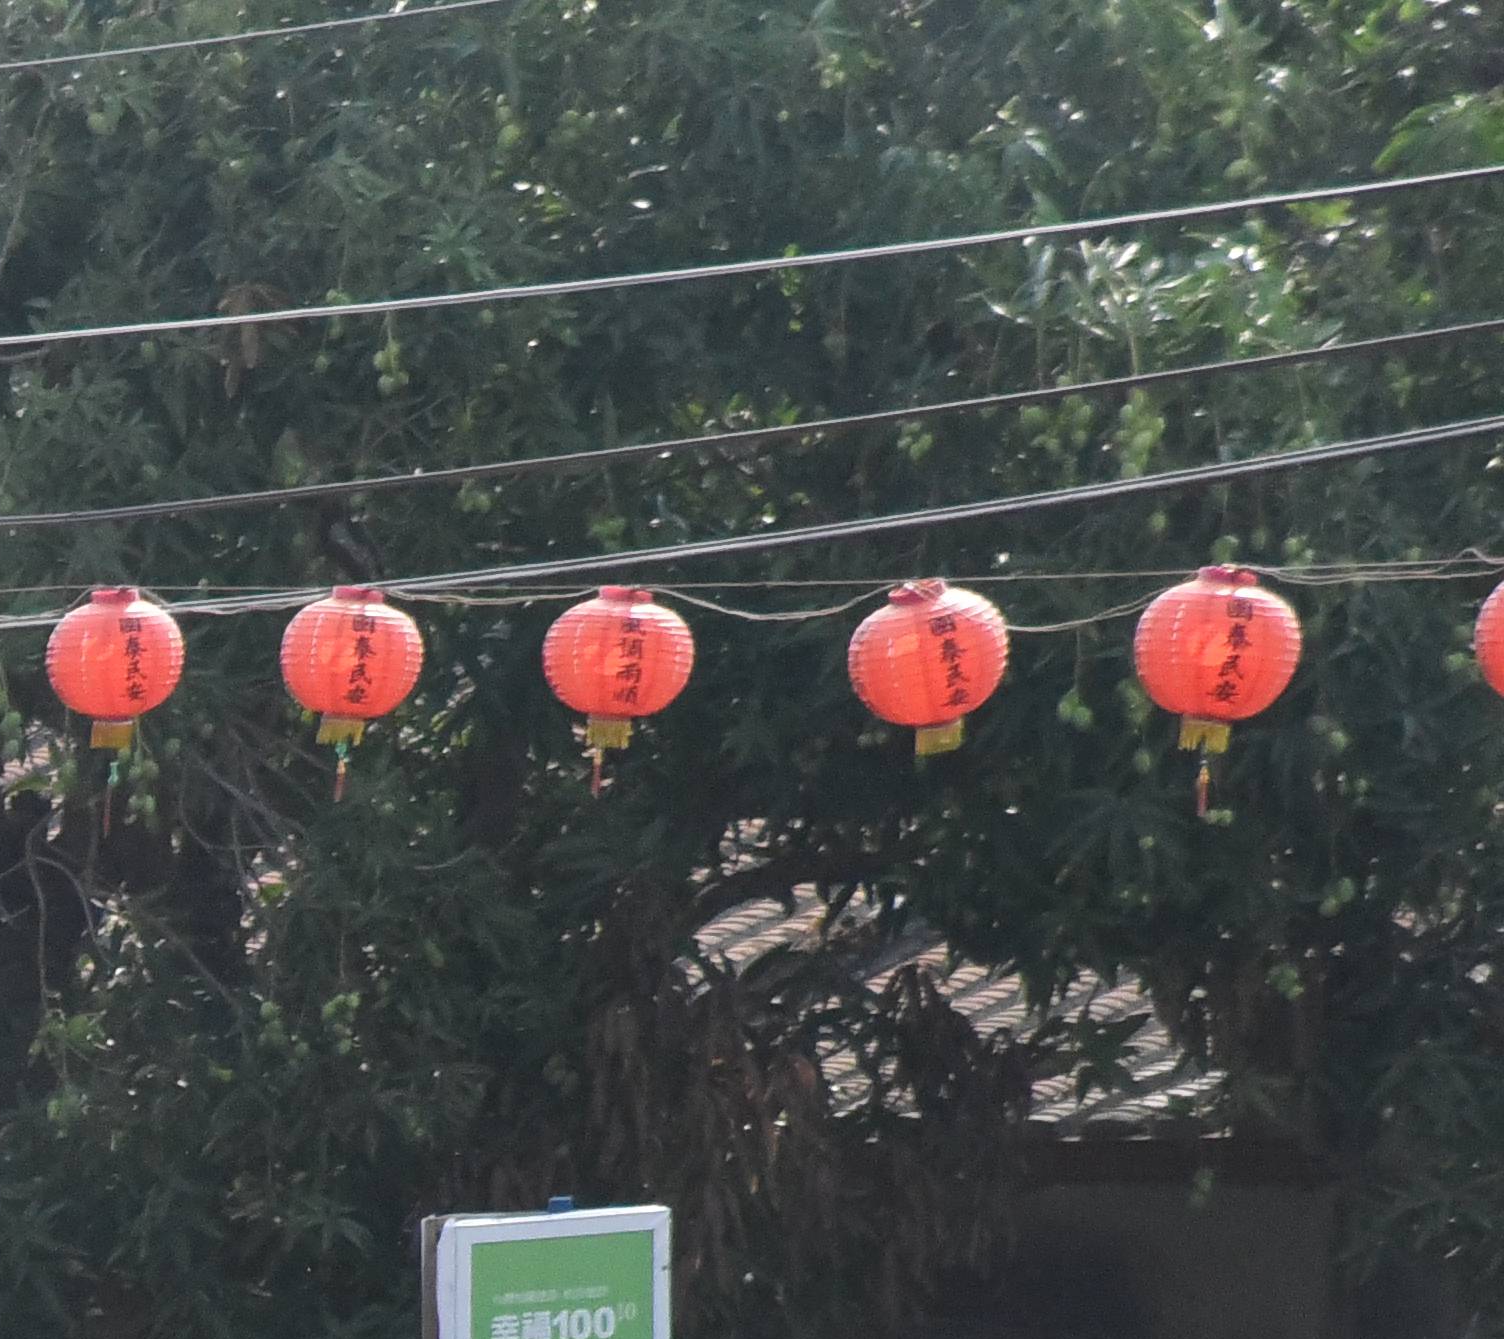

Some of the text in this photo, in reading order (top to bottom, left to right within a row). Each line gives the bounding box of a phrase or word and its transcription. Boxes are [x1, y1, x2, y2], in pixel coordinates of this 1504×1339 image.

[119, 616, 149, 702] 國泰民安
[342, 615, 377, 706] 國泰民安
[613, 618, 648, 705] 風調雨順
[929, 615, 971, 709] 國泰民安
[1207, 597, 1256, 705] 國泰民安
